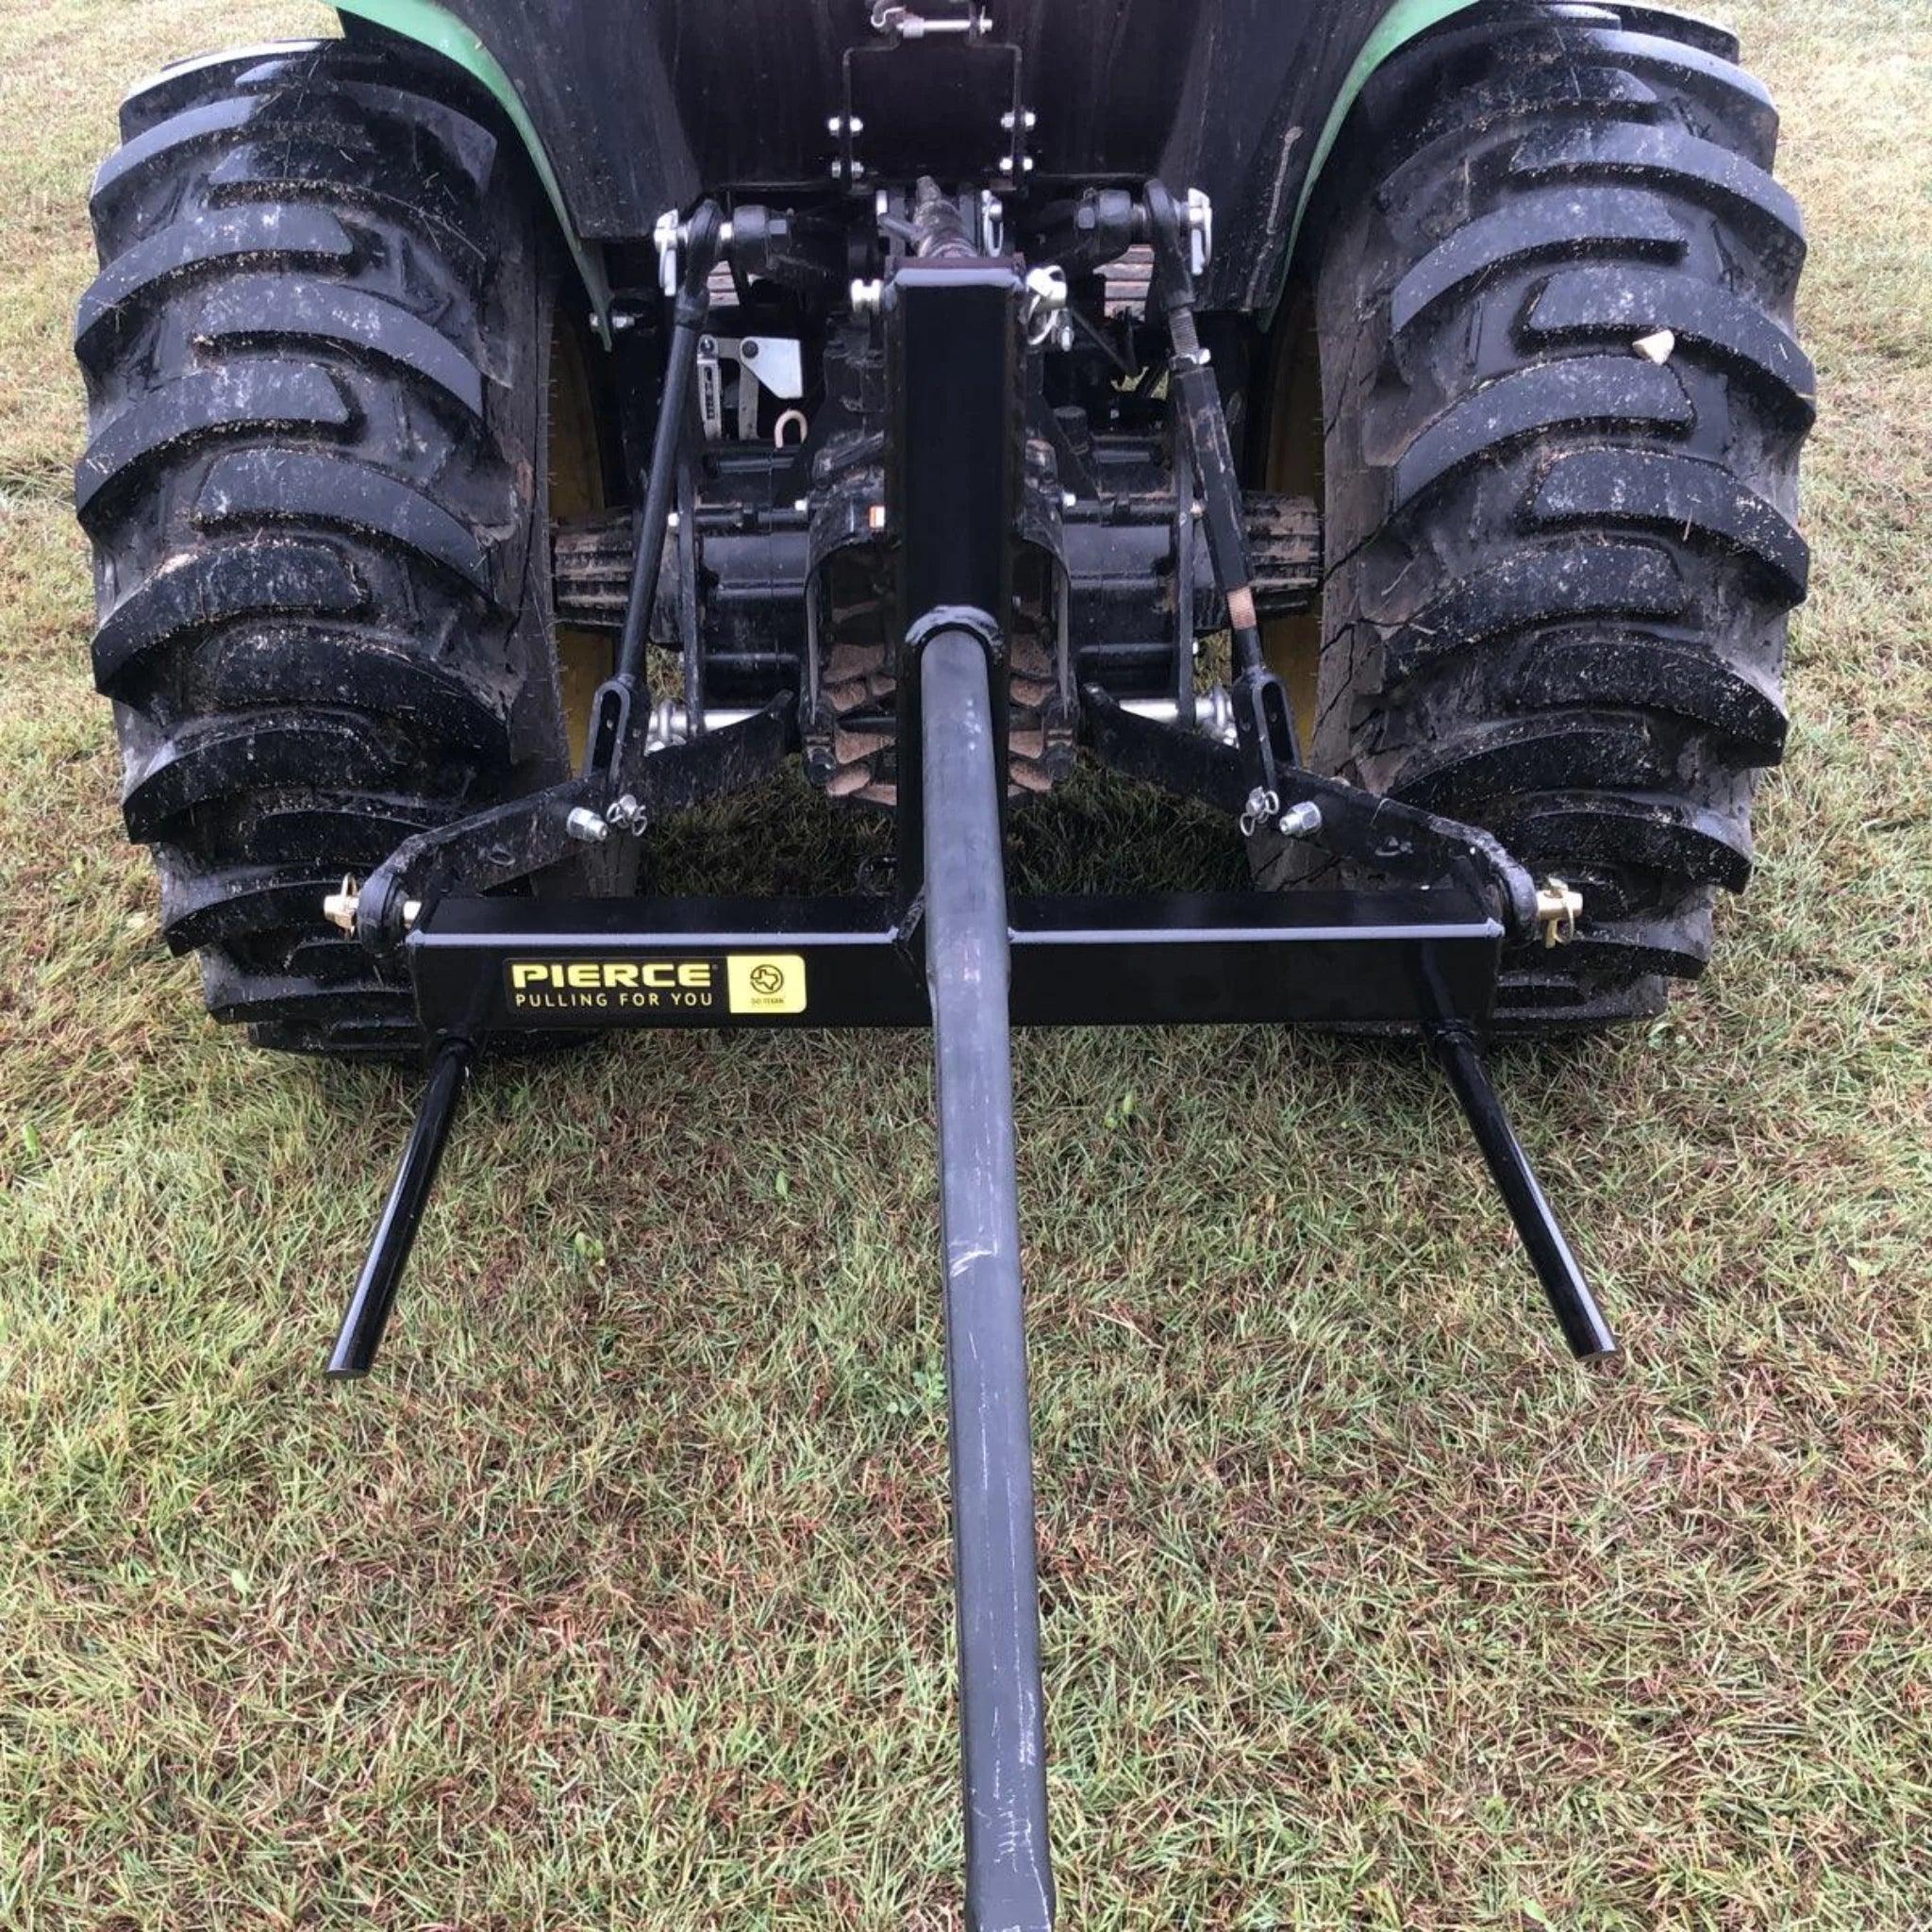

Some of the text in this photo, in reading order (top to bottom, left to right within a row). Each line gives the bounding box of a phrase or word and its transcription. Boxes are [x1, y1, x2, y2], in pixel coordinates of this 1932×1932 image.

[512, 964, 711, 988] PIERCE
[515, 992, 713, 1007] PULLING FOR YOU
